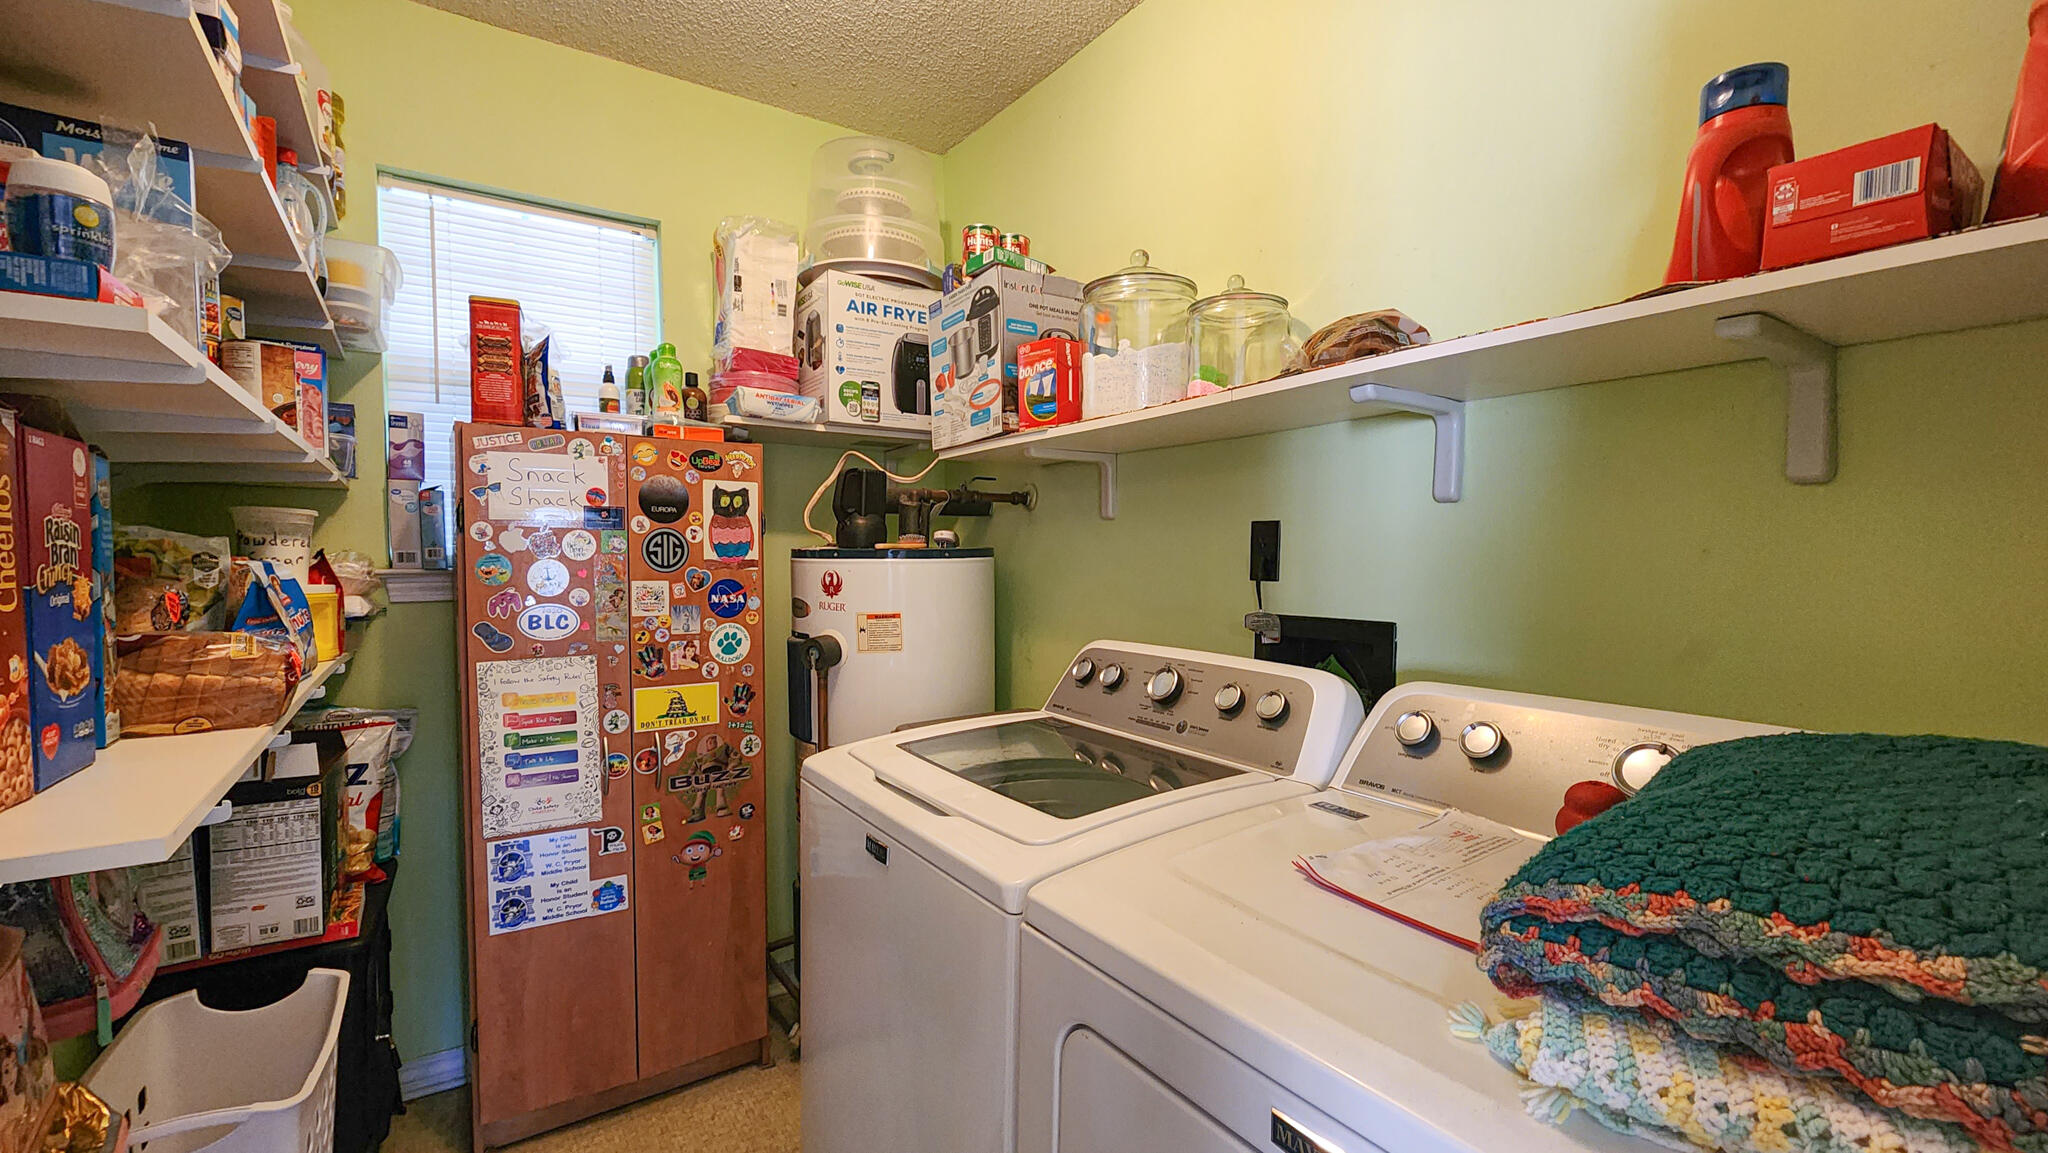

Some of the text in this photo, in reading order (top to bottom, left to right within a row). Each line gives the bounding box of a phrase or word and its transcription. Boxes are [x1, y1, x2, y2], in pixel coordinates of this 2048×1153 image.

[846, 299, 927, 324] AIR FRYE
[1018, 357, 1055, 380] bounce
[476, 433, 520, 447] JUSTICE
[506, 457, 586, 485] Snack
[509, 486, 582, 507] Shack
[651, 506, 677, 514] EUROPA
[45, 517, 80, 548] Raisin
[51, 543, 78, 570] Bran
[648, 533, 682, 567] SIG
[37, 564, 72, 594] Crunch
[711, 594, 745, 604] NASA
[819, 601, 846, 612] RUGER
[528, 614, 569, 631] BLC
[640, 720, 662, 729] DON'T
[665, 718, 687, 726] TREAD
[566, 908, 588, 917] School
